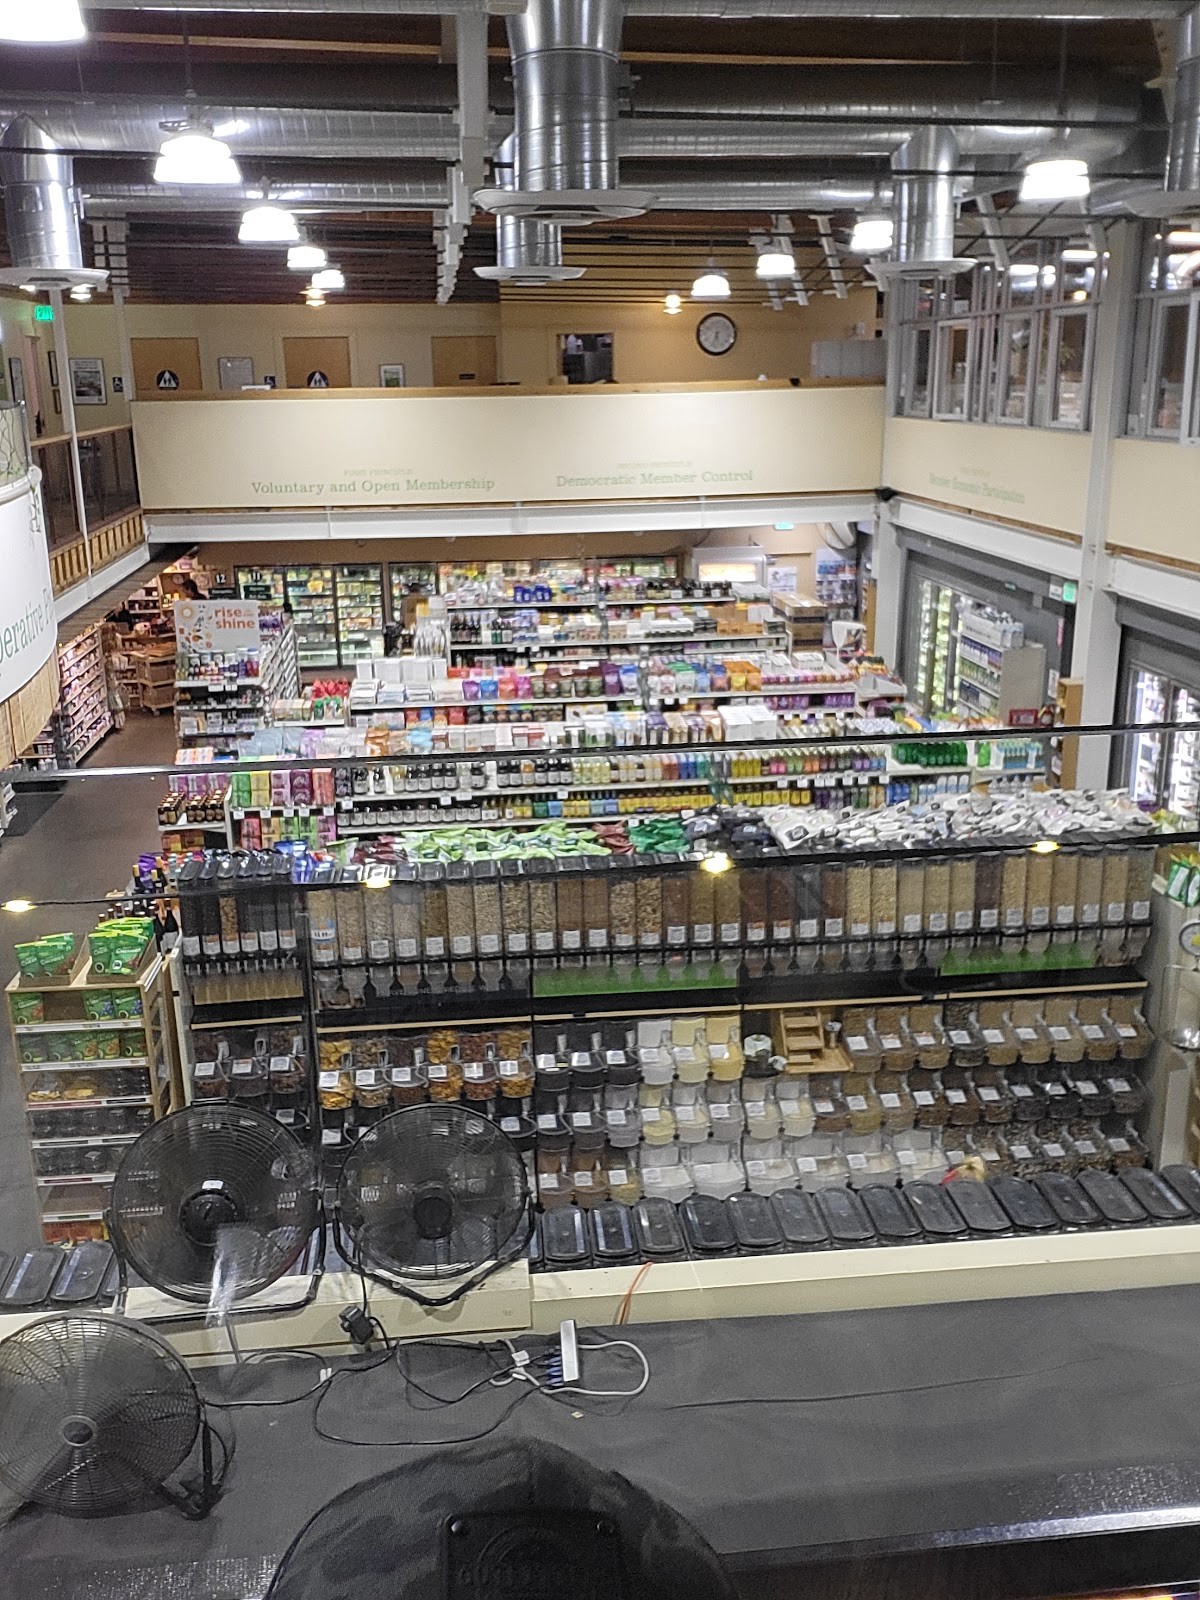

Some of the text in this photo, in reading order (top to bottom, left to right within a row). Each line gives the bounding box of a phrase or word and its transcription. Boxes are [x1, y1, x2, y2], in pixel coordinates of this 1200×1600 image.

[556, 470, 753, 487] Democratic Member Control
[251, 477, 495, 496] Voluntary and Open Membership
[216, 573, 227, 584] 12
[214, 607, 242, 618] rise
[215, 619, 255, 629] shine
